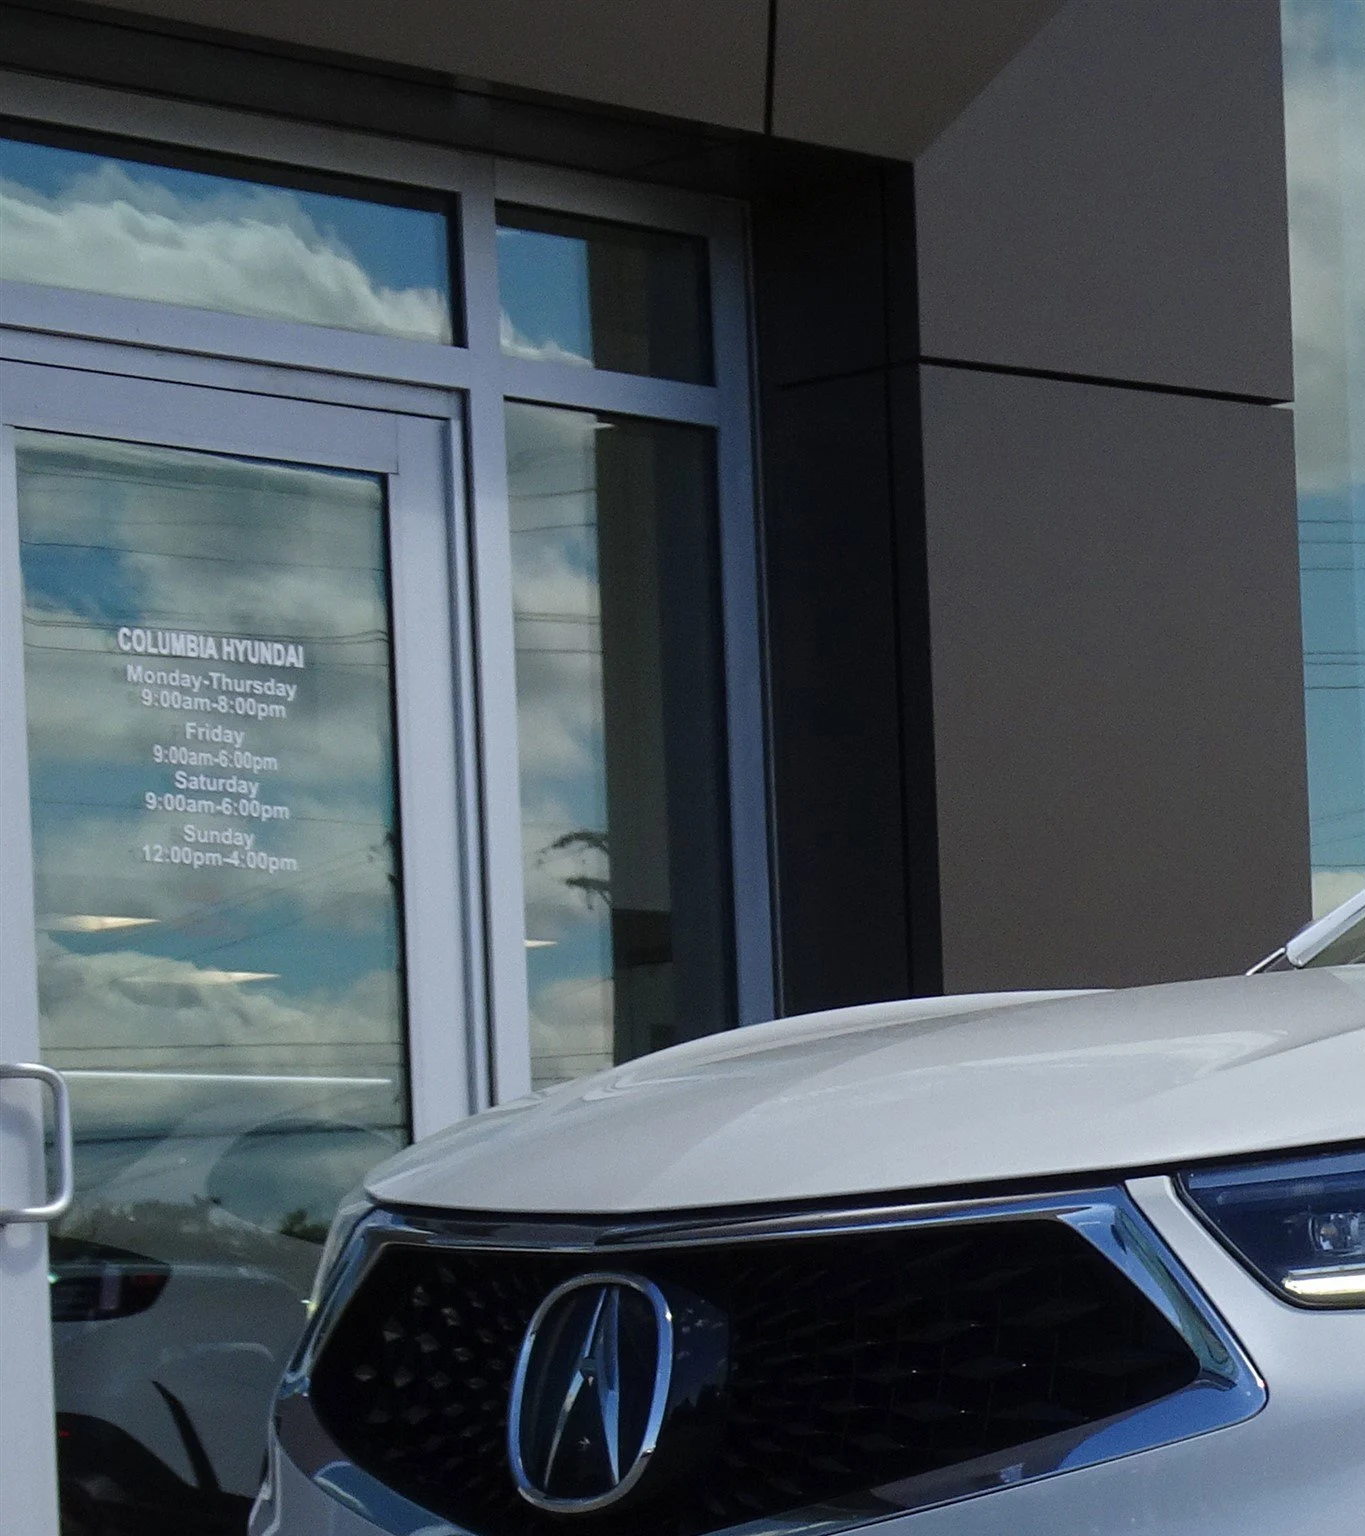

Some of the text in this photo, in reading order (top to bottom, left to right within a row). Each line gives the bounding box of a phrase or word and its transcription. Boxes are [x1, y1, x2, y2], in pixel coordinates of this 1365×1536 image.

[117, 627, 305, 669] COLUMBIA HYUNDAI
[126, 664, 297, 701] Monday-Thursday
[141, 688, 287, 720] 9:00am-8:00pm
[185, 722, 245, 748] Friday
[153, 744, 279, 774] 9:00am-6:00pm
[174, 770, 259, 799] Saturday
[145, 791, 290, 821] 9:00am-6:00pm
[183, 824, 256, 850] Sunday
[143, 844, 298, 875] 12:00pm-4:00pm
